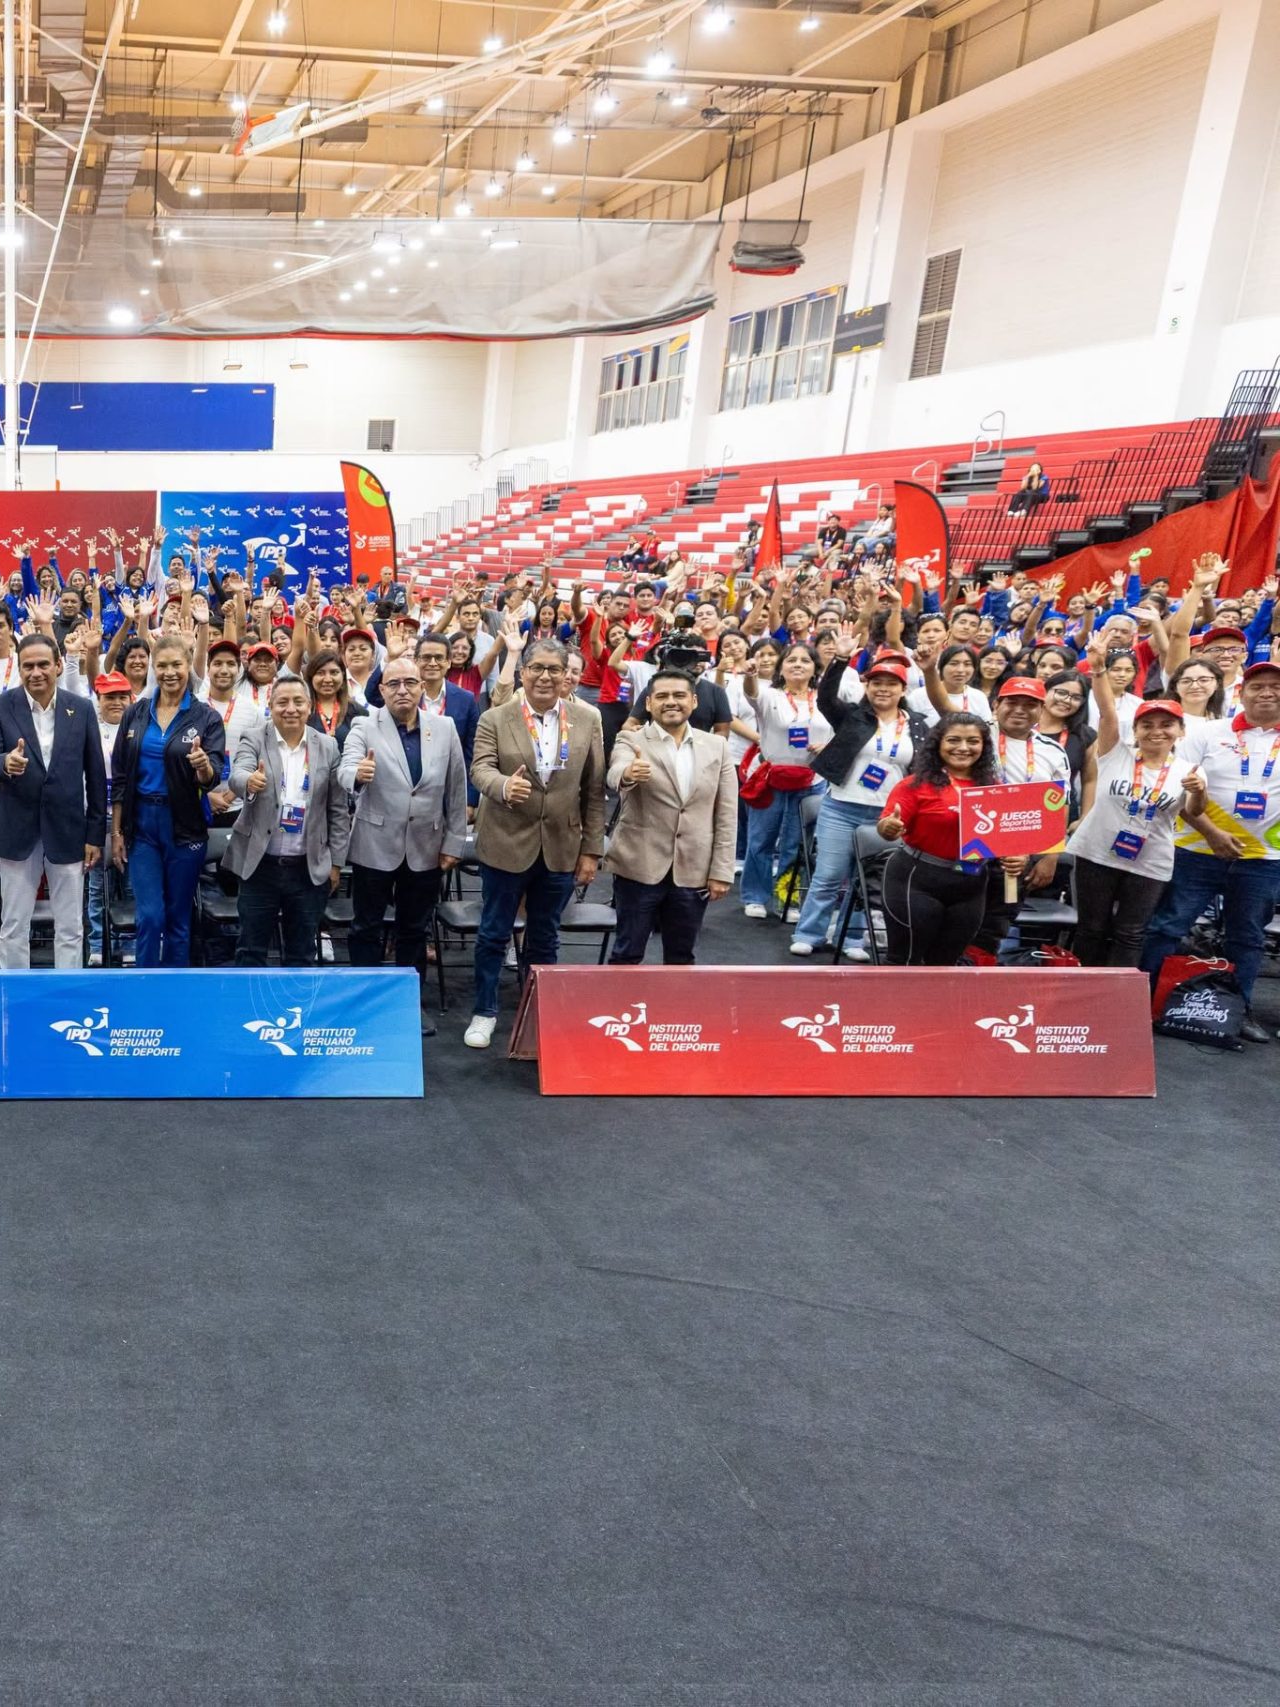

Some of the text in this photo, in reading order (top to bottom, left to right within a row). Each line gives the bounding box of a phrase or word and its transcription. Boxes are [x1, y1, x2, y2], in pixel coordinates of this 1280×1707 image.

[1000, 810, 1042, 821] JUEGOS
[1000, 818, 1042, 828] deportivos
[1165, 1007, 1229, 1023] campeones
[303, 1028, 356, 1037] INSTITUTO
[605, 1024, 630, 1036] IPD
[648, 1024, 702, 1033] INSTITUTO
[798, 1025, 823, 1036] IPD
[842, 1026, 895, 1034] INSTITUTO
[992, 1026, 1017, 1037] IPD
[1036, 1026, 1089, 1034] INSTITUTO
[66, 1029, 91, 1040] IPD
[110, 1029, 163, 1037] INSTITUTO
[259, 1028, 284, 1040] IPD
[110, 1038, 160, 1046] PERUANO
[303, 1038, 353, 1046] PERUANO
[649, 1034, 699, 1042] PERUANO
[842, 1035, 892, 1043] PERUANO
[1036, 1035, 1086, 1043] PERUANO
[303, 1047, 374, 1055] DEL DEPORTE
[649, 1043, 720, 1052] DEL DEPORTE
[843, 1044, 914, 1052] DEL DEPORTE
[1037, 1045, 1108, 1053] DEL DEPORTE
[110, 1048, 181, 1056] DEL DEPORTE
